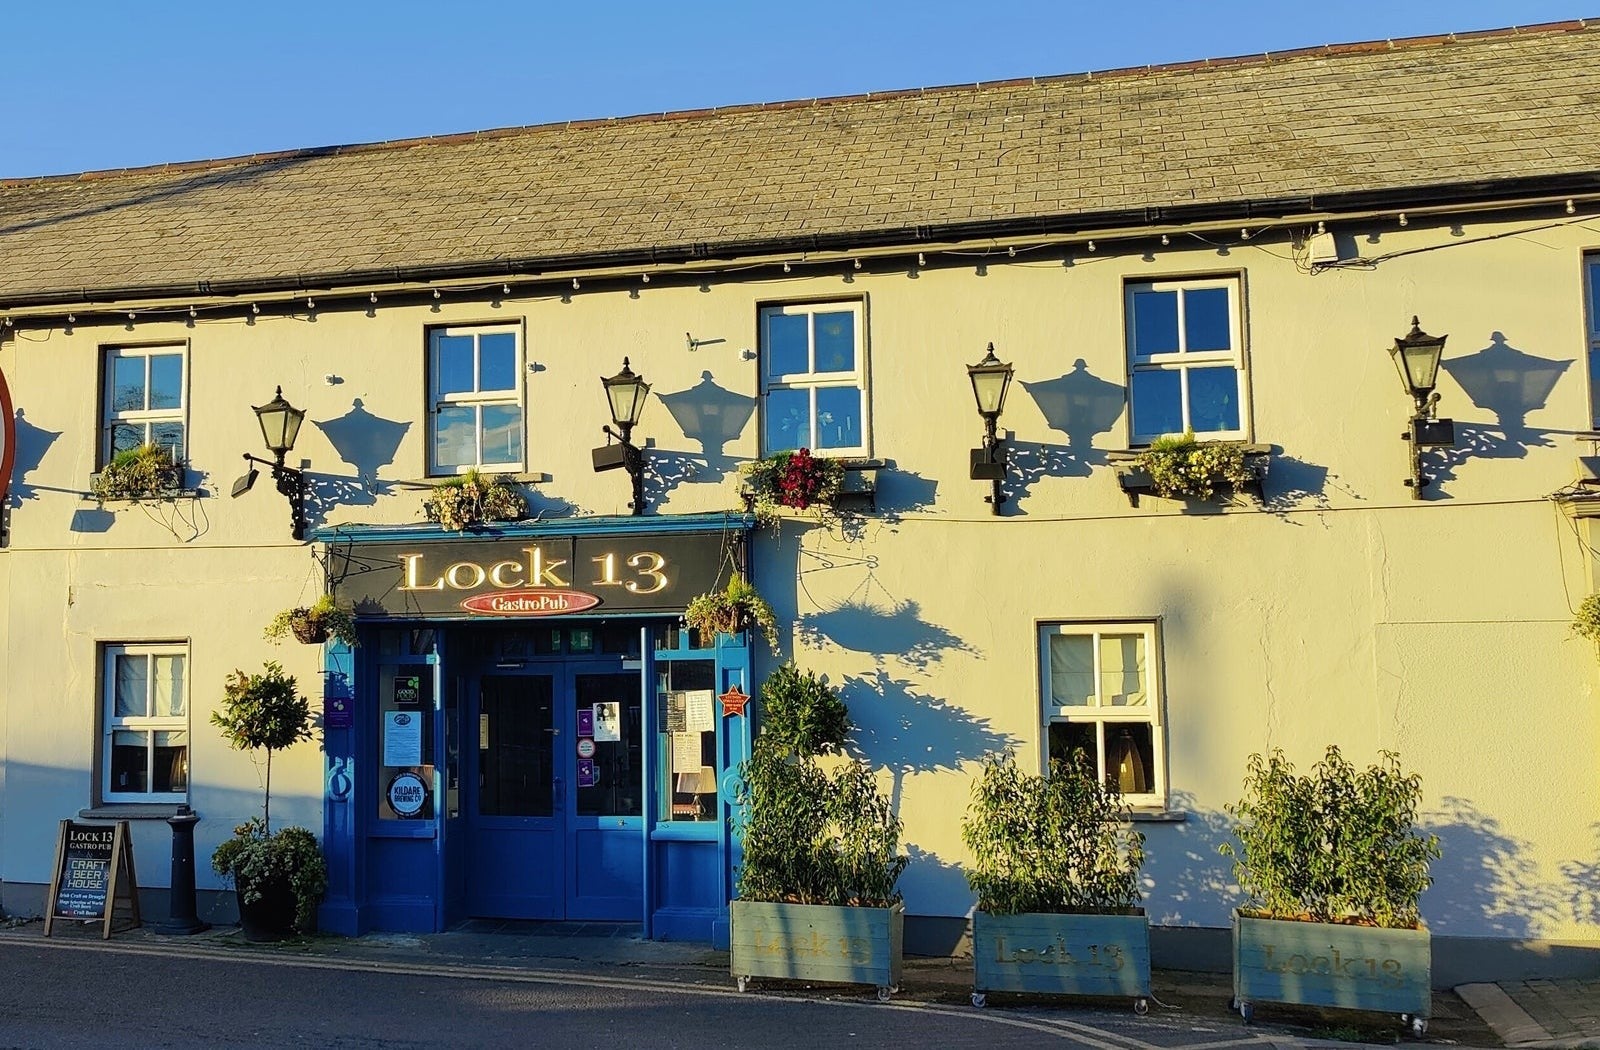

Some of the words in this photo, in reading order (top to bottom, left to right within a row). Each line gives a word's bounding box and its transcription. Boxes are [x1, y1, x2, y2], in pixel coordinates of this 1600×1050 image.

[397, 544, 570, 591] Lock
[591, 552, 669, 594] 13
[491, 597, 568, 611] GastroPub
[393, 786, 421, 794] KILDARE
[394, 795, 414, 803] BREWING
[70, 830, 99, 842] LOCK
[102, 832, 113, 842] 13
[69, 842, 97, 850] GASTRO
[71, 860, 106, 870] CRAFT
[73, 870, 102, 879] BEER
[67, 879, 103, 889] HOUSE
